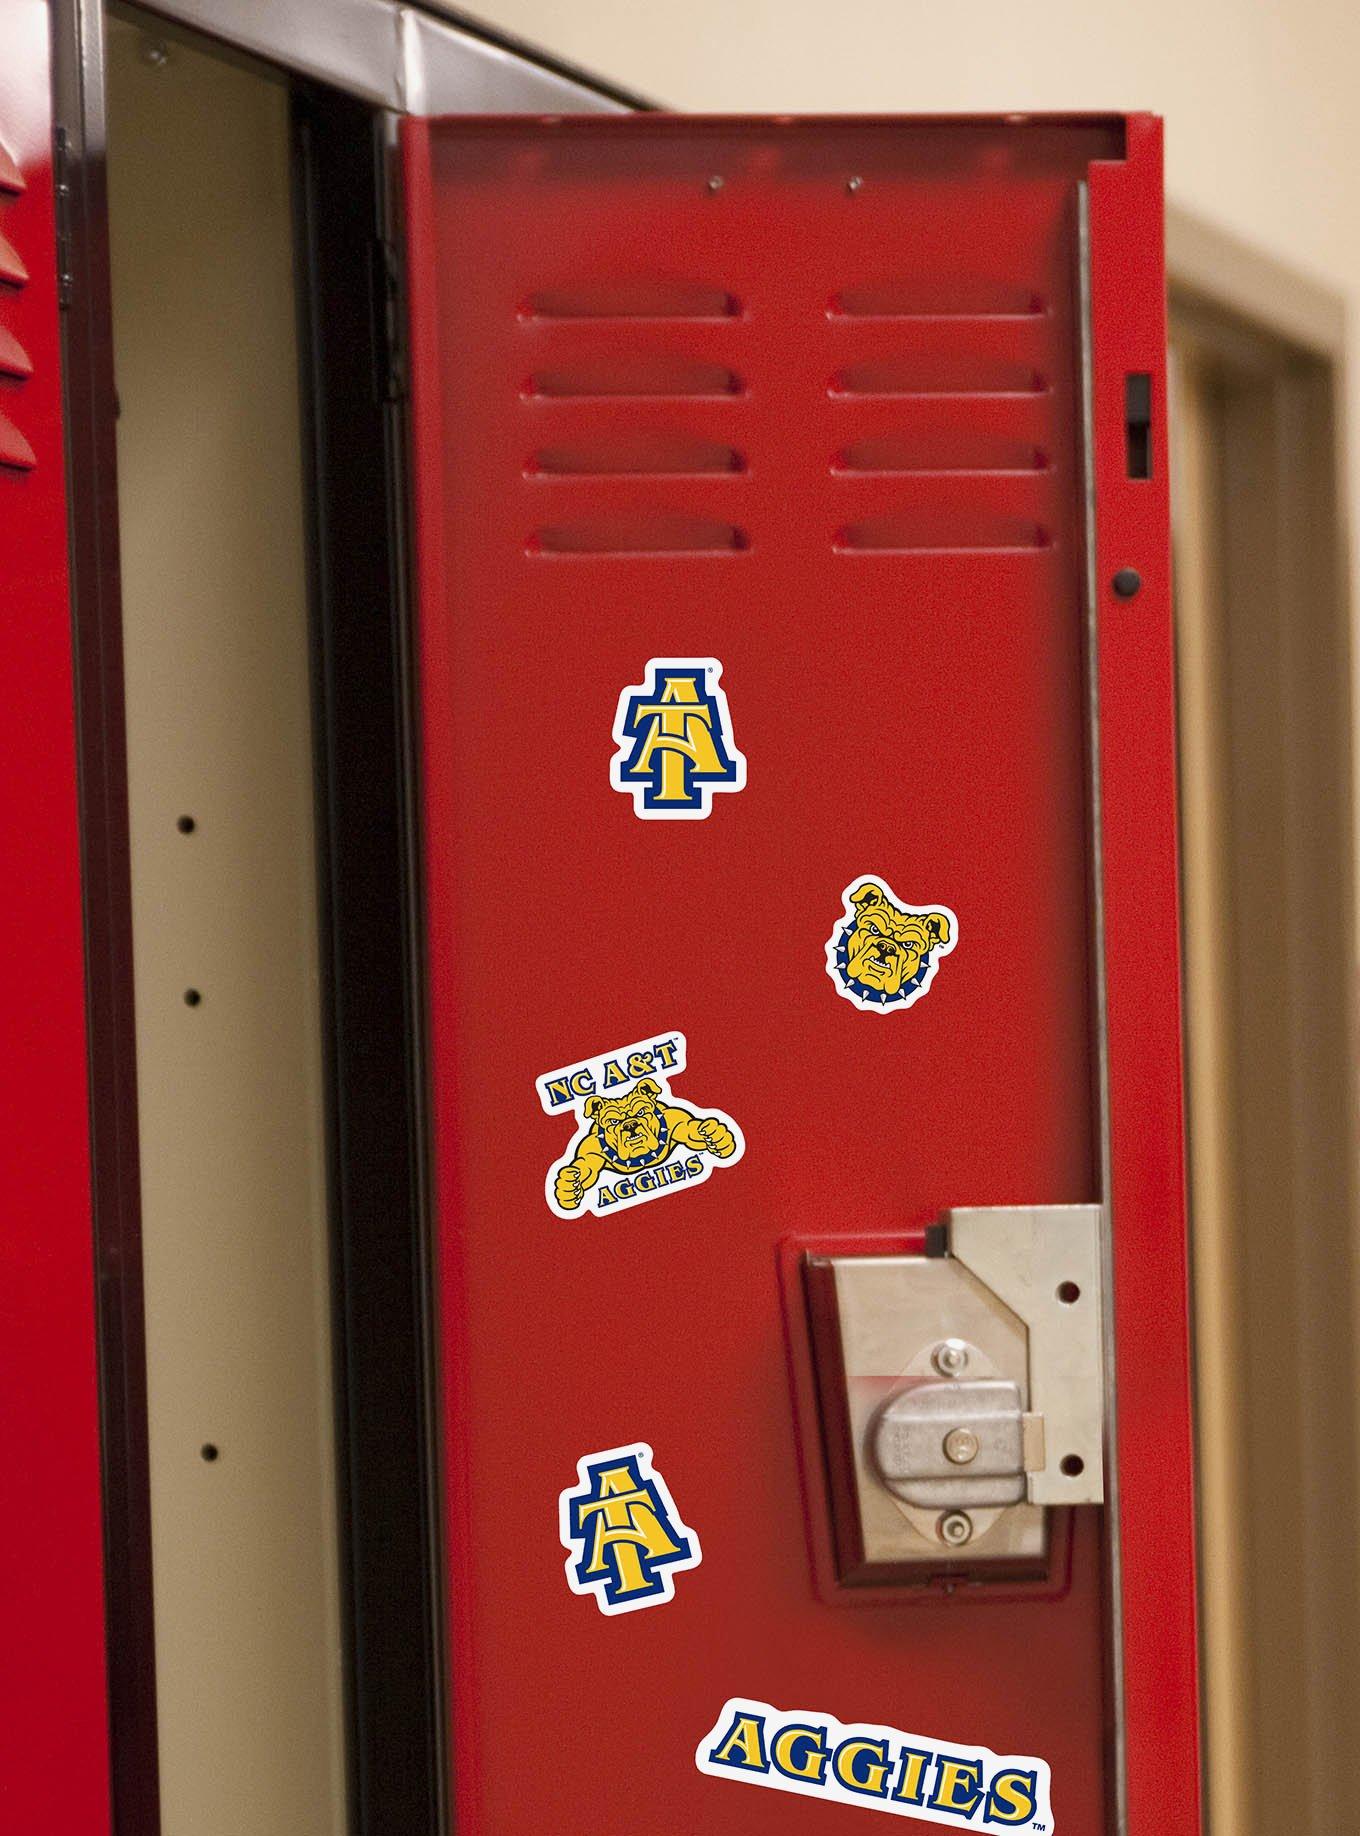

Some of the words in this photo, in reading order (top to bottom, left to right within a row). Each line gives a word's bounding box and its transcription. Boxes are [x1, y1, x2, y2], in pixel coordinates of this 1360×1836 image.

[545, 1068, 596, 1107] NC
[603, 1040, 677, 1089] A&T
[598, 1154, 704, 1208] AGGIES
[709, 1711, 1037, 1827] AGGIES
